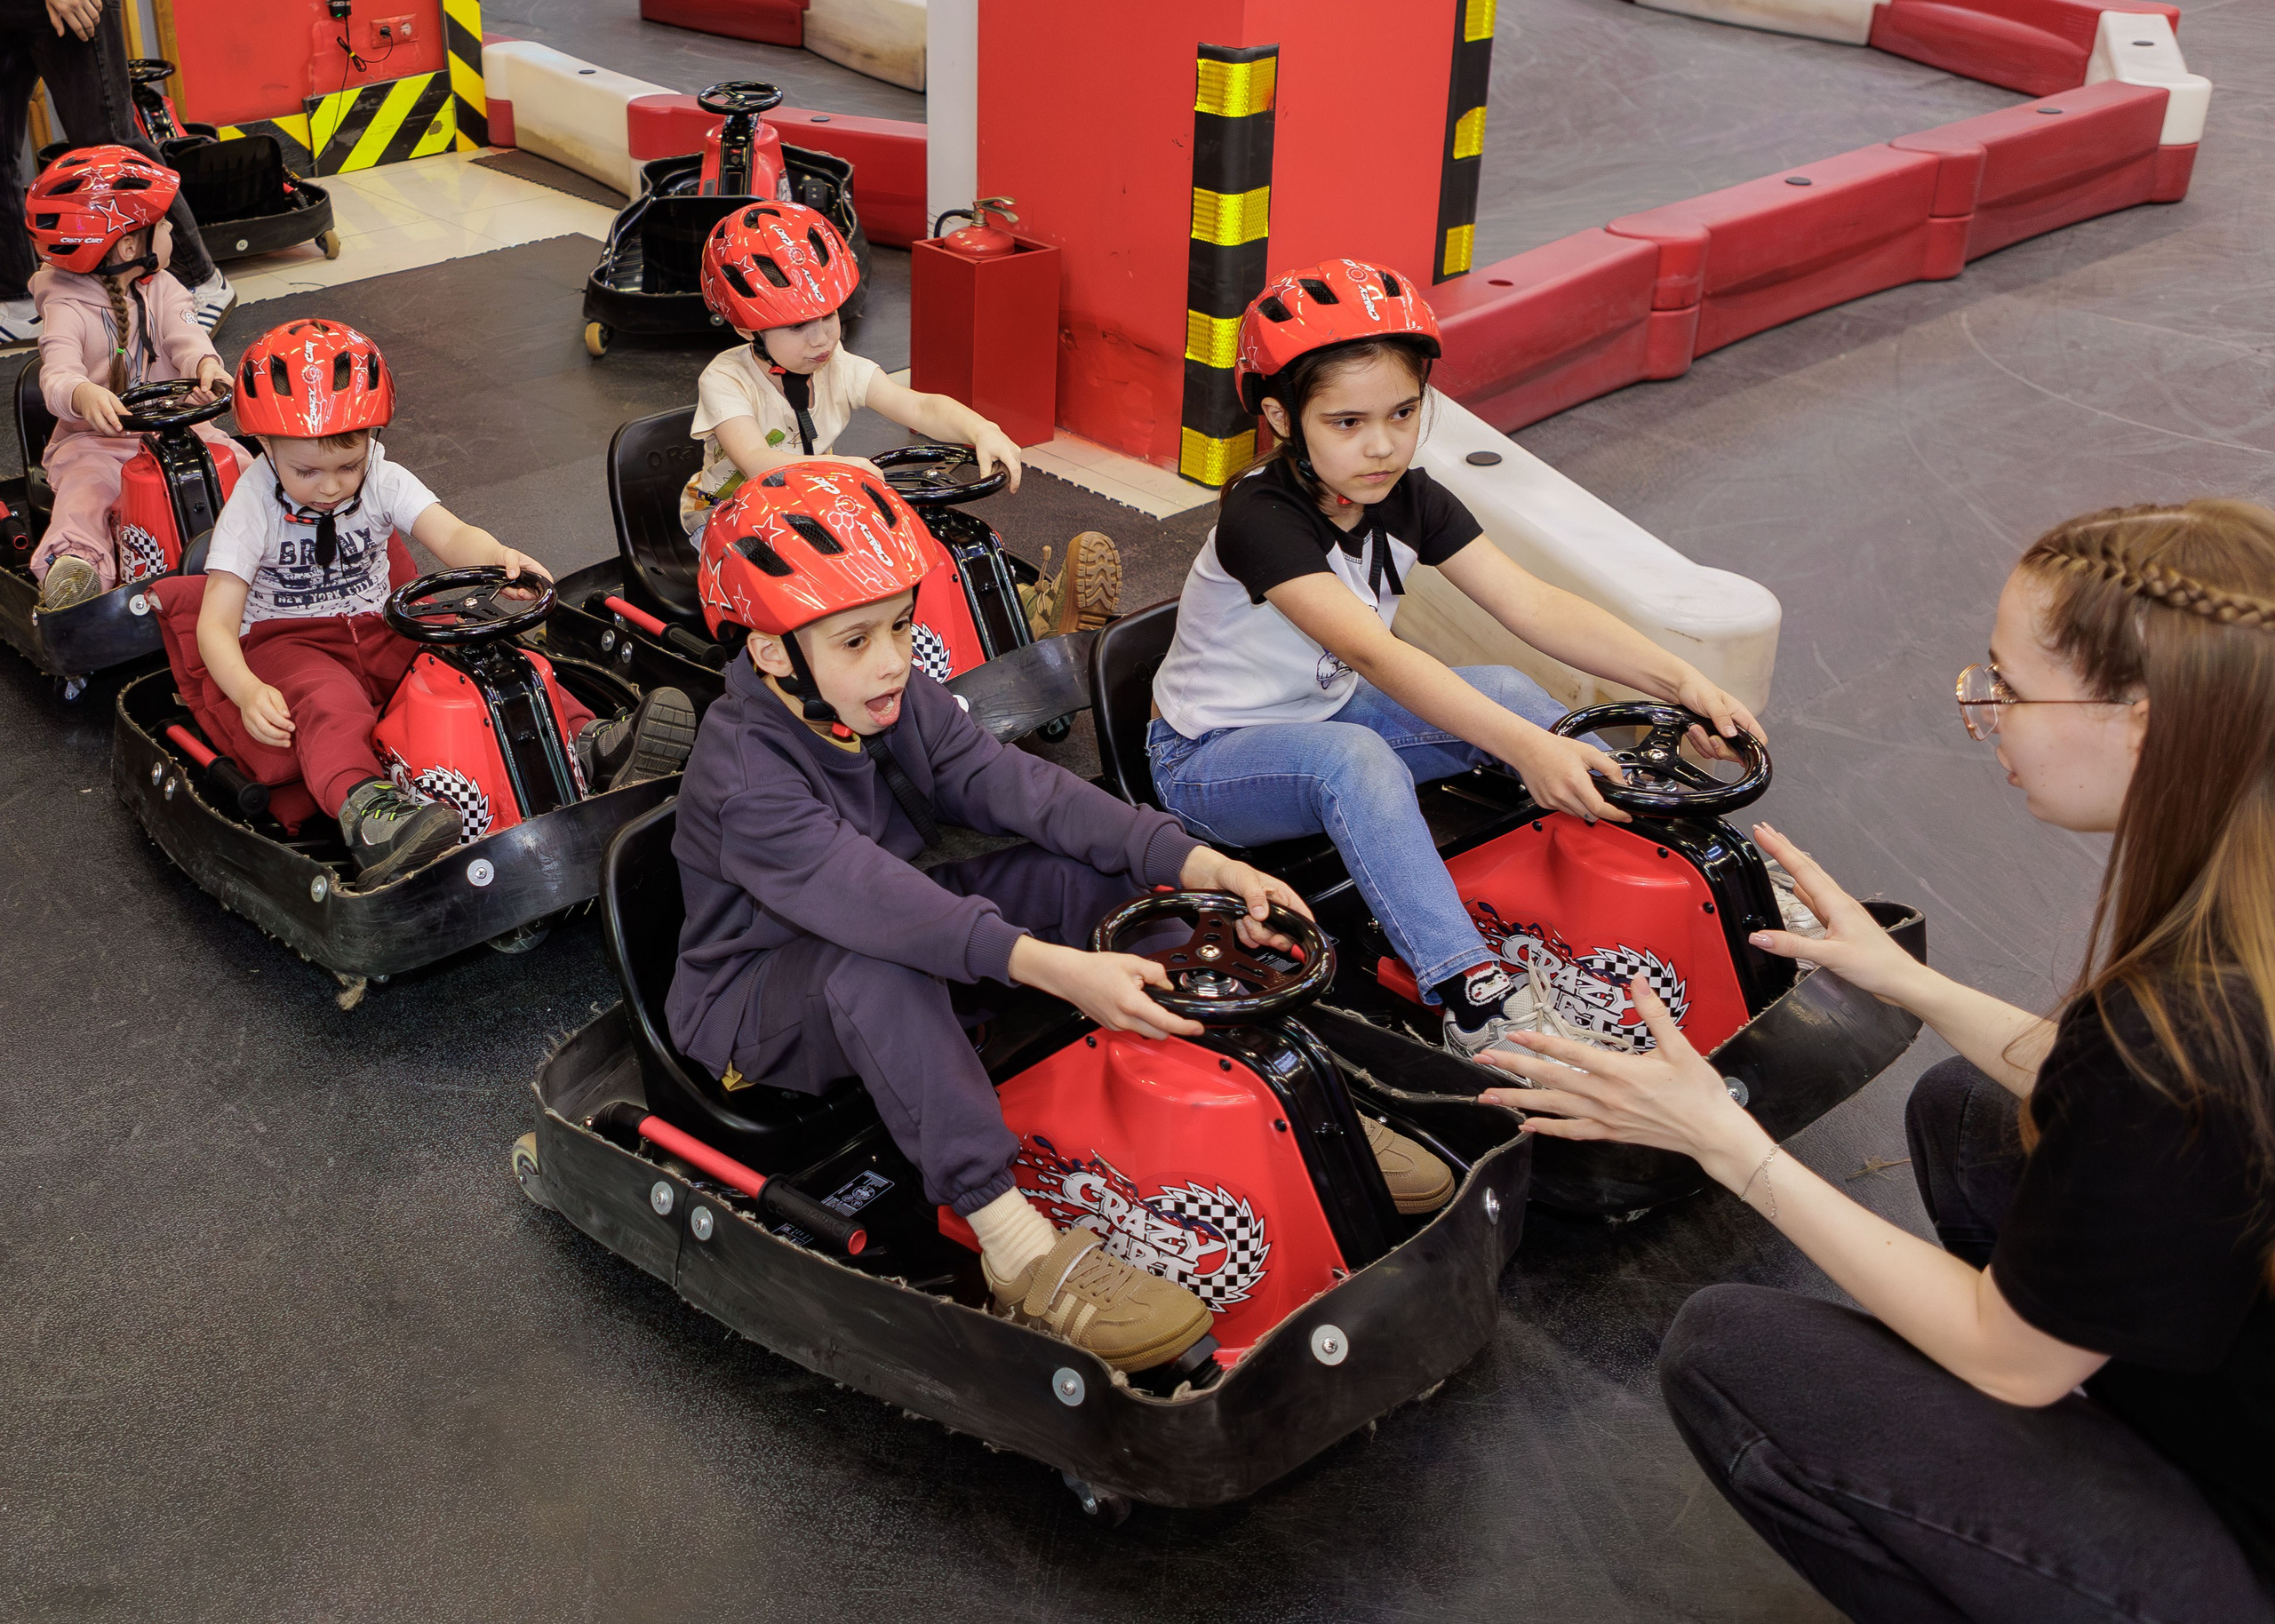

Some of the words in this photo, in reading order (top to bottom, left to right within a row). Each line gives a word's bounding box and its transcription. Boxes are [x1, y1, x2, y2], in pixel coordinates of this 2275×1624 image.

[278, 526, 377, 566] BRNX
[278, 593, 304, 604] NEW
[310, 590, 341, 604] YORK
[346, 578, 371, 596] CITY
[1498, 933, 1635, 1018] CRAZY
[1059, 1168, 1228, 1264] CRAZY
